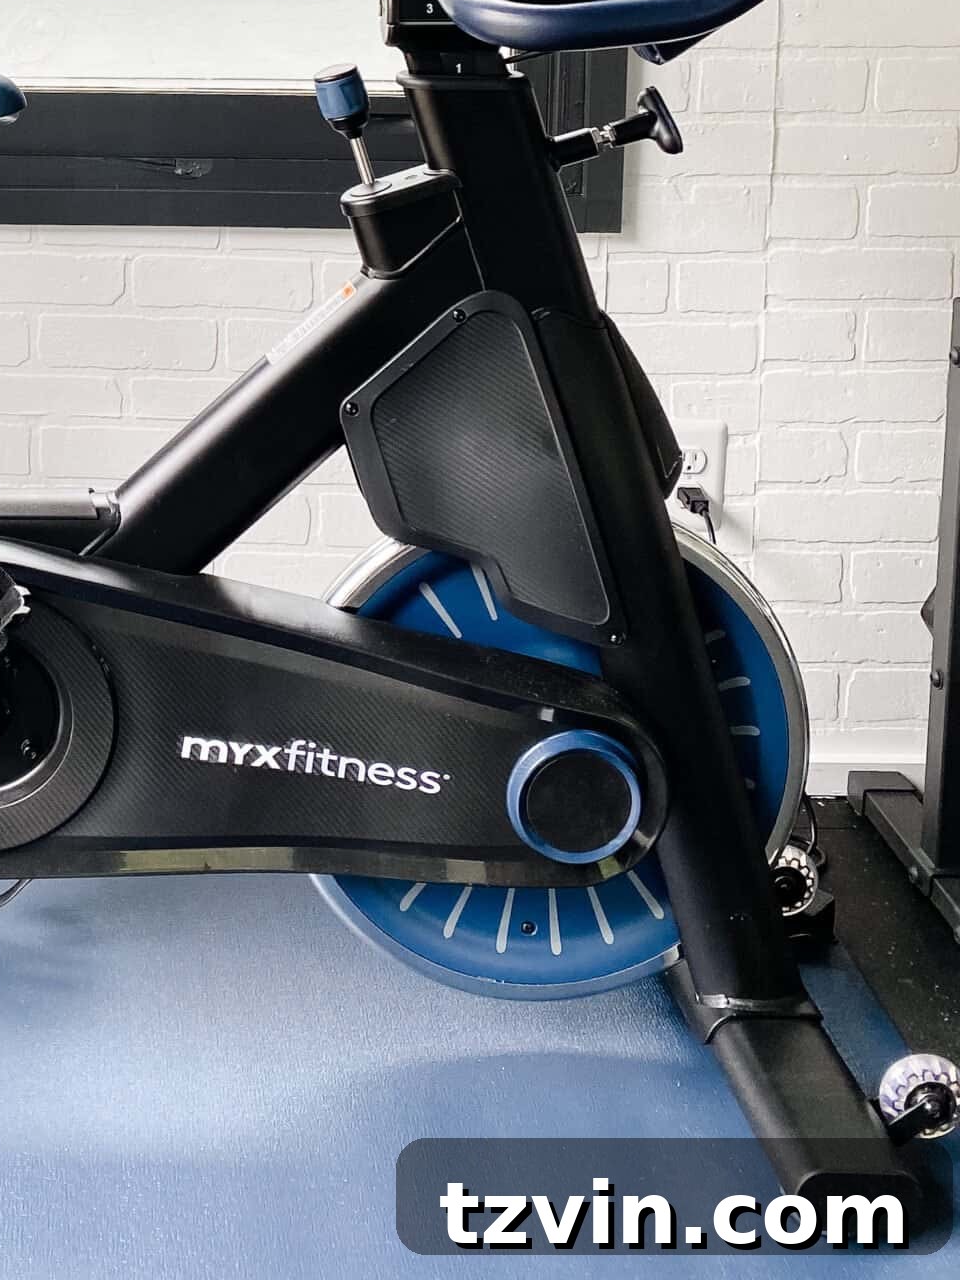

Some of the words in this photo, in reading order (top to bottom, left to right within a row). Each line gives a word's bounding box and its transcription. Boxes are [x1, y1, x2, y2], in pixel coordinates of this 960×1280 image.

[426, 3, 434, 14] 3
[455, 63, 461, 73] 1
[180, 735, 442, 794] myxfitness
